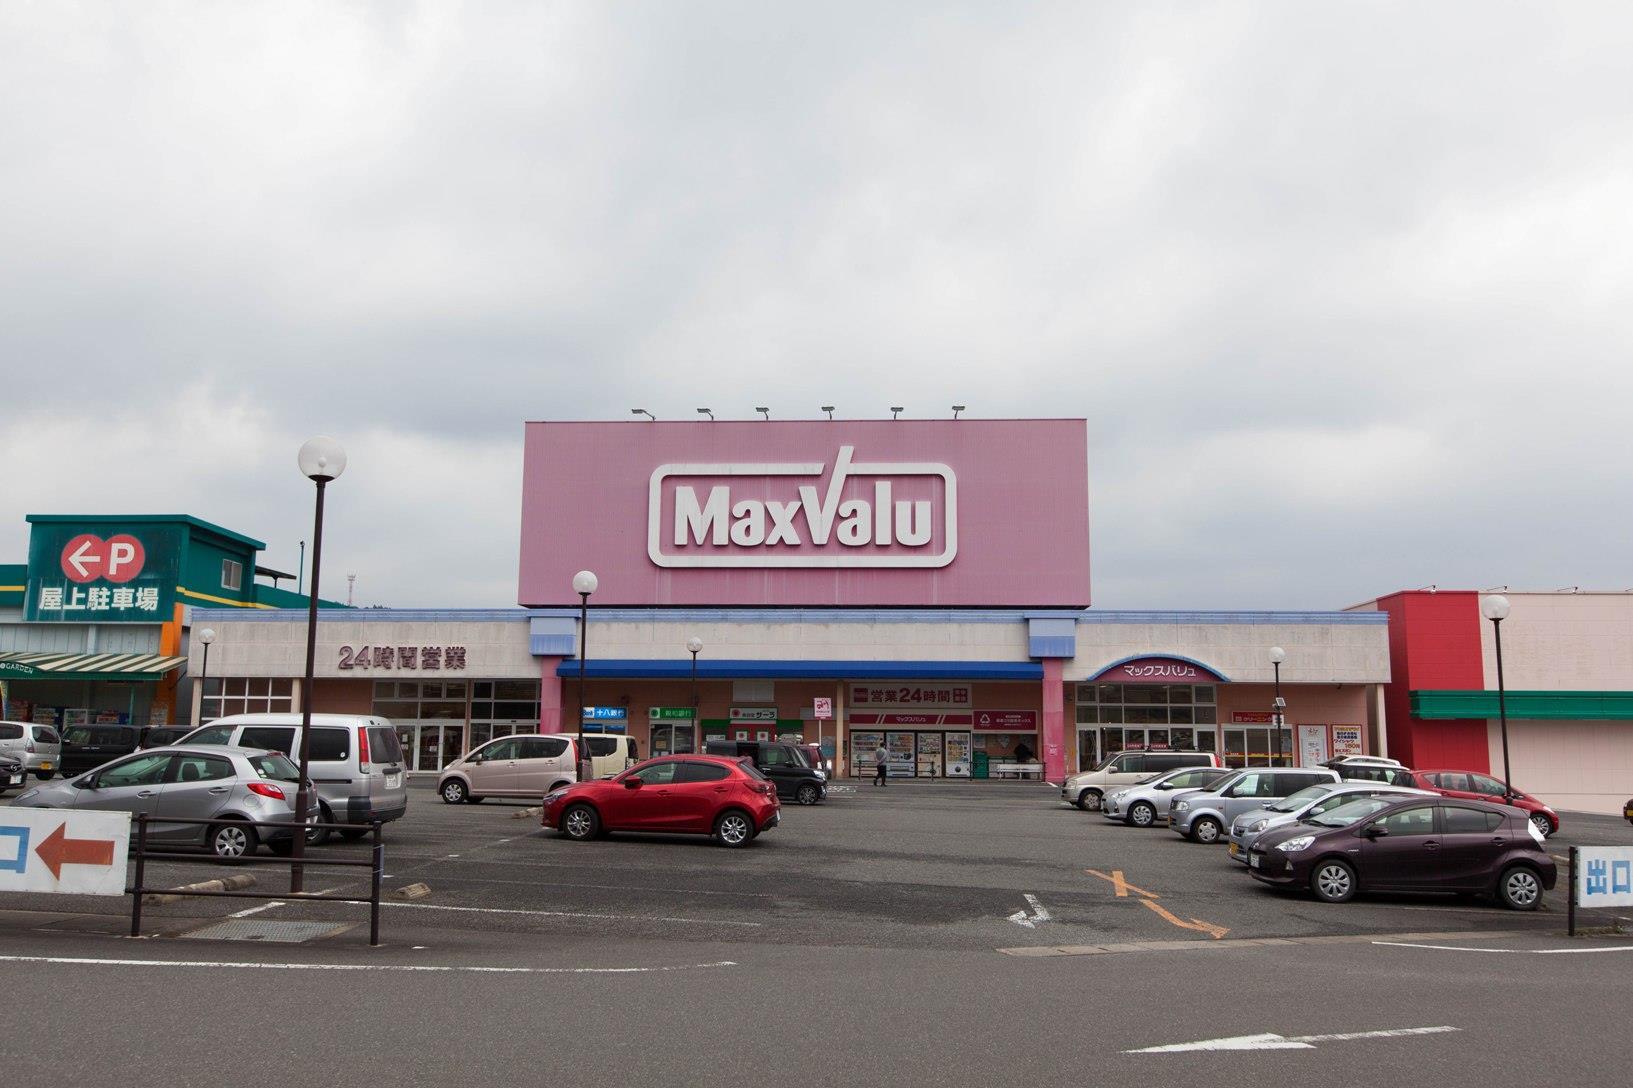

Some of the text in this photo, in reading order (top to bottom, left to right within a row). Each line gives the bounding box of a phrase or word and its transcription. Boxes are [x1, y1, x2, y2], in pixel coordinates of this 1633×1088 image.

[674, 446, 932, 546] MaxValu
[109, 543, 135, 575] P
[39, 586, 159, 611] 屋上駐車場
[338, 645, 467, 671] 24時間営業
[1123, 665, 1197, 677] マックスバリュ
[871, 687, 951, 703] 営業24時間
[596, 708, 625, 717] 十八銀行
[1586, 859, 1632, 896] 出口
